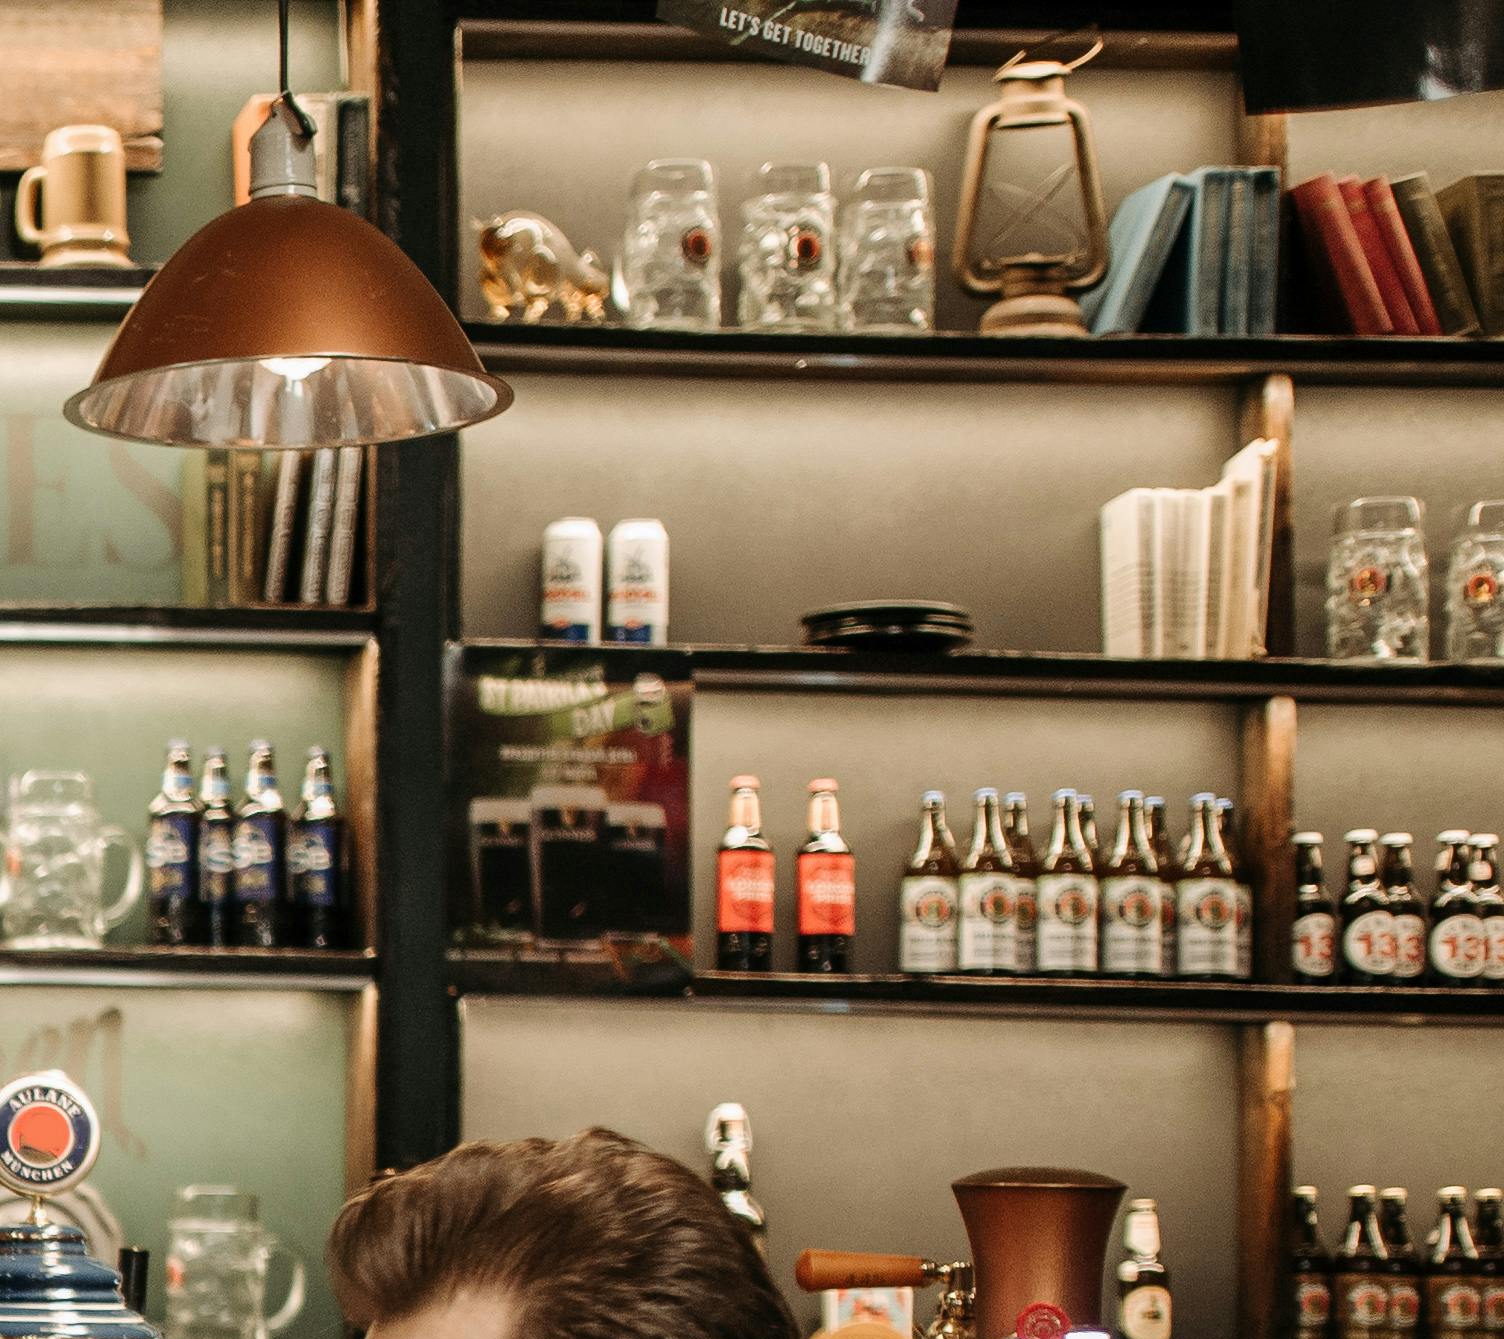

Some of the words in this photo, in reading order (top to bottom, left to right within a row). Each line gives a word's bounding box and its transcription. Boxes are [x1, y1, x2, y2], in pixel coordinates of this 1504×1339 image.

[719, 6, 760, 36] LET'S
[762, 20, 792, 45] GET
[796, 29, 873, 66] TOGETHER
